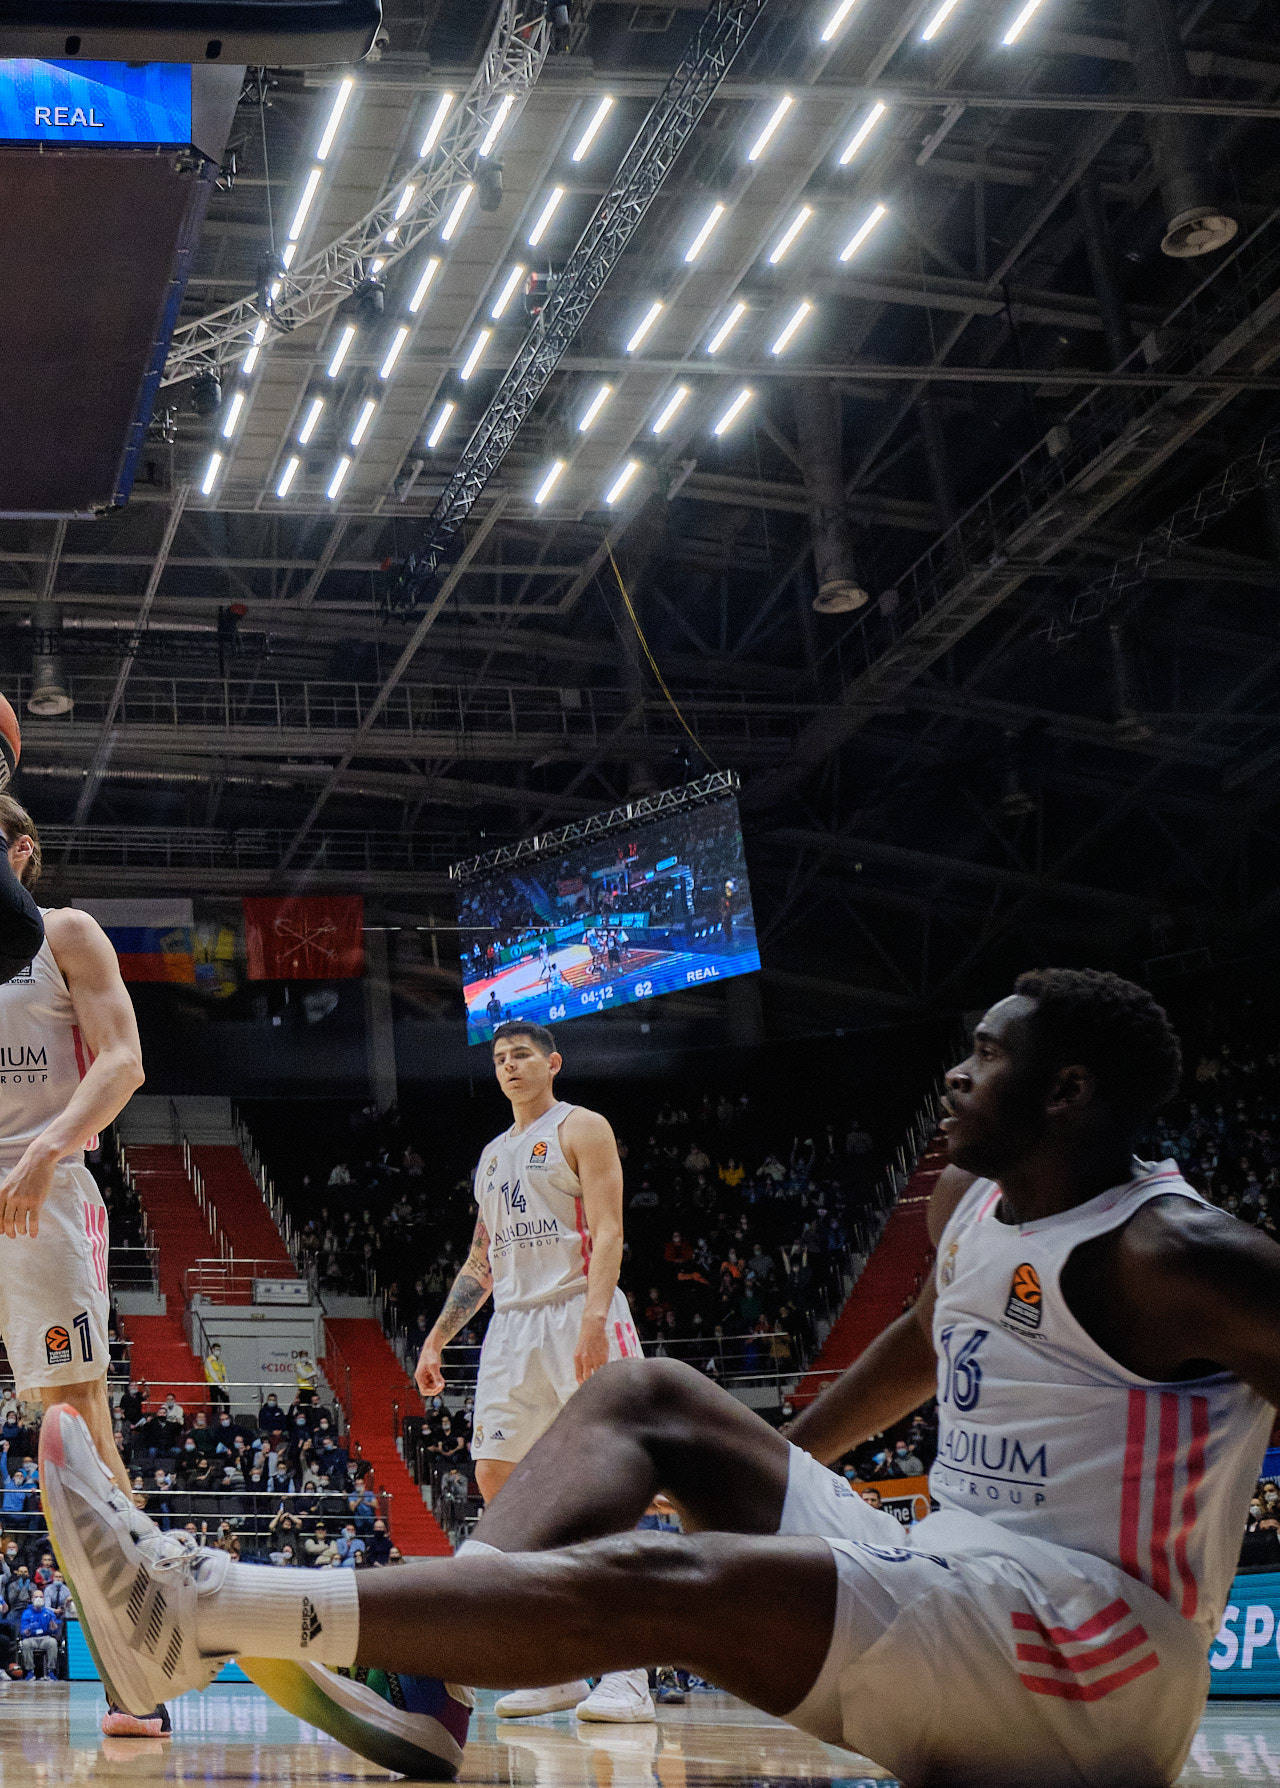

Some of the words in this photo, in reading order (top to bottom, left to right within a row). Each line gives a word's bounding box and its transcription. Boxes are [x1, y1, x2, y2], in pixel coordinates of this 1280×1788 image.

[35, 106, 105, 127] REAL
[549, 1003, 566, 1021] 64
[581, 985, 614, 1005] 04:12
[634, 980, 653, 998] 62
[687, 965, 720, 983] REAL
[596, 1000, 604, 1011] 4
[501, 1179, 527, 1215] 14
[520, 1237, 560, 1250] GROUP
[73, 1311, 93, 1363] 1
[941, 1325, 990, 1412] 16
[300, 1596, 310, 1648] adidas
[1209, 1604, 1280, 1670] SP
